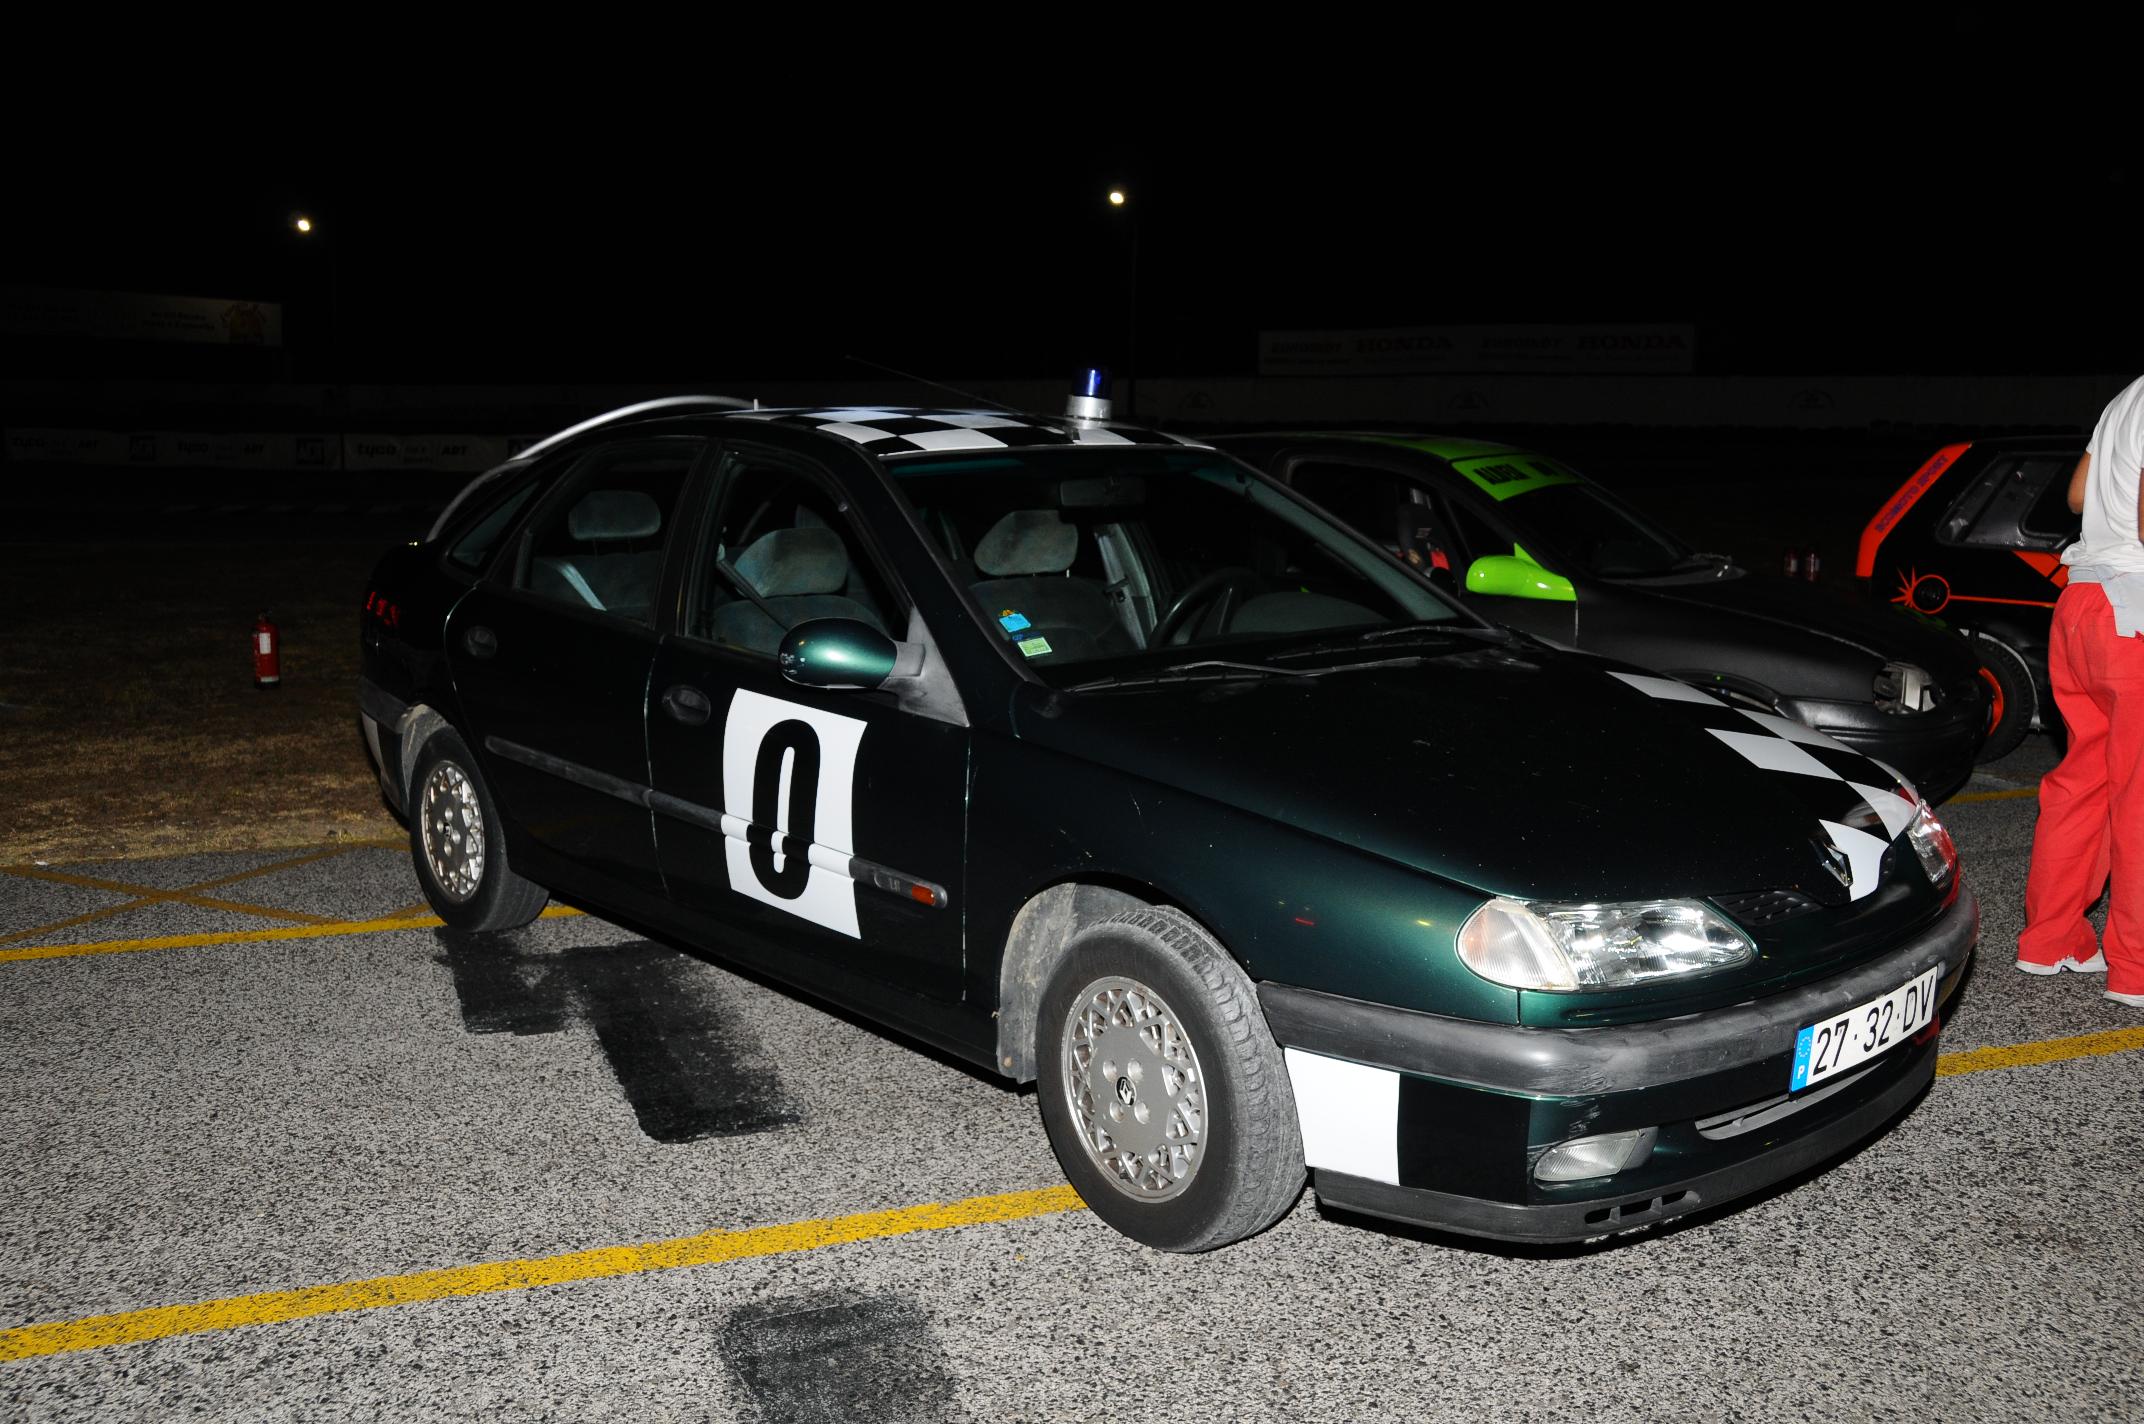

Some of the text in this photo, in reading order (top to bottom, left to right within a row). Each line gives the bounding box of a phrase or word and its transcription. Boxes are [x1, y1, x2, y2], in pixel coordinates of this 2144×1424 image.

[1356, 335, 1454, 353] HONDA
[1577, 335, 1688, 351] HONDA
[749, 719, 821, 900] 0
